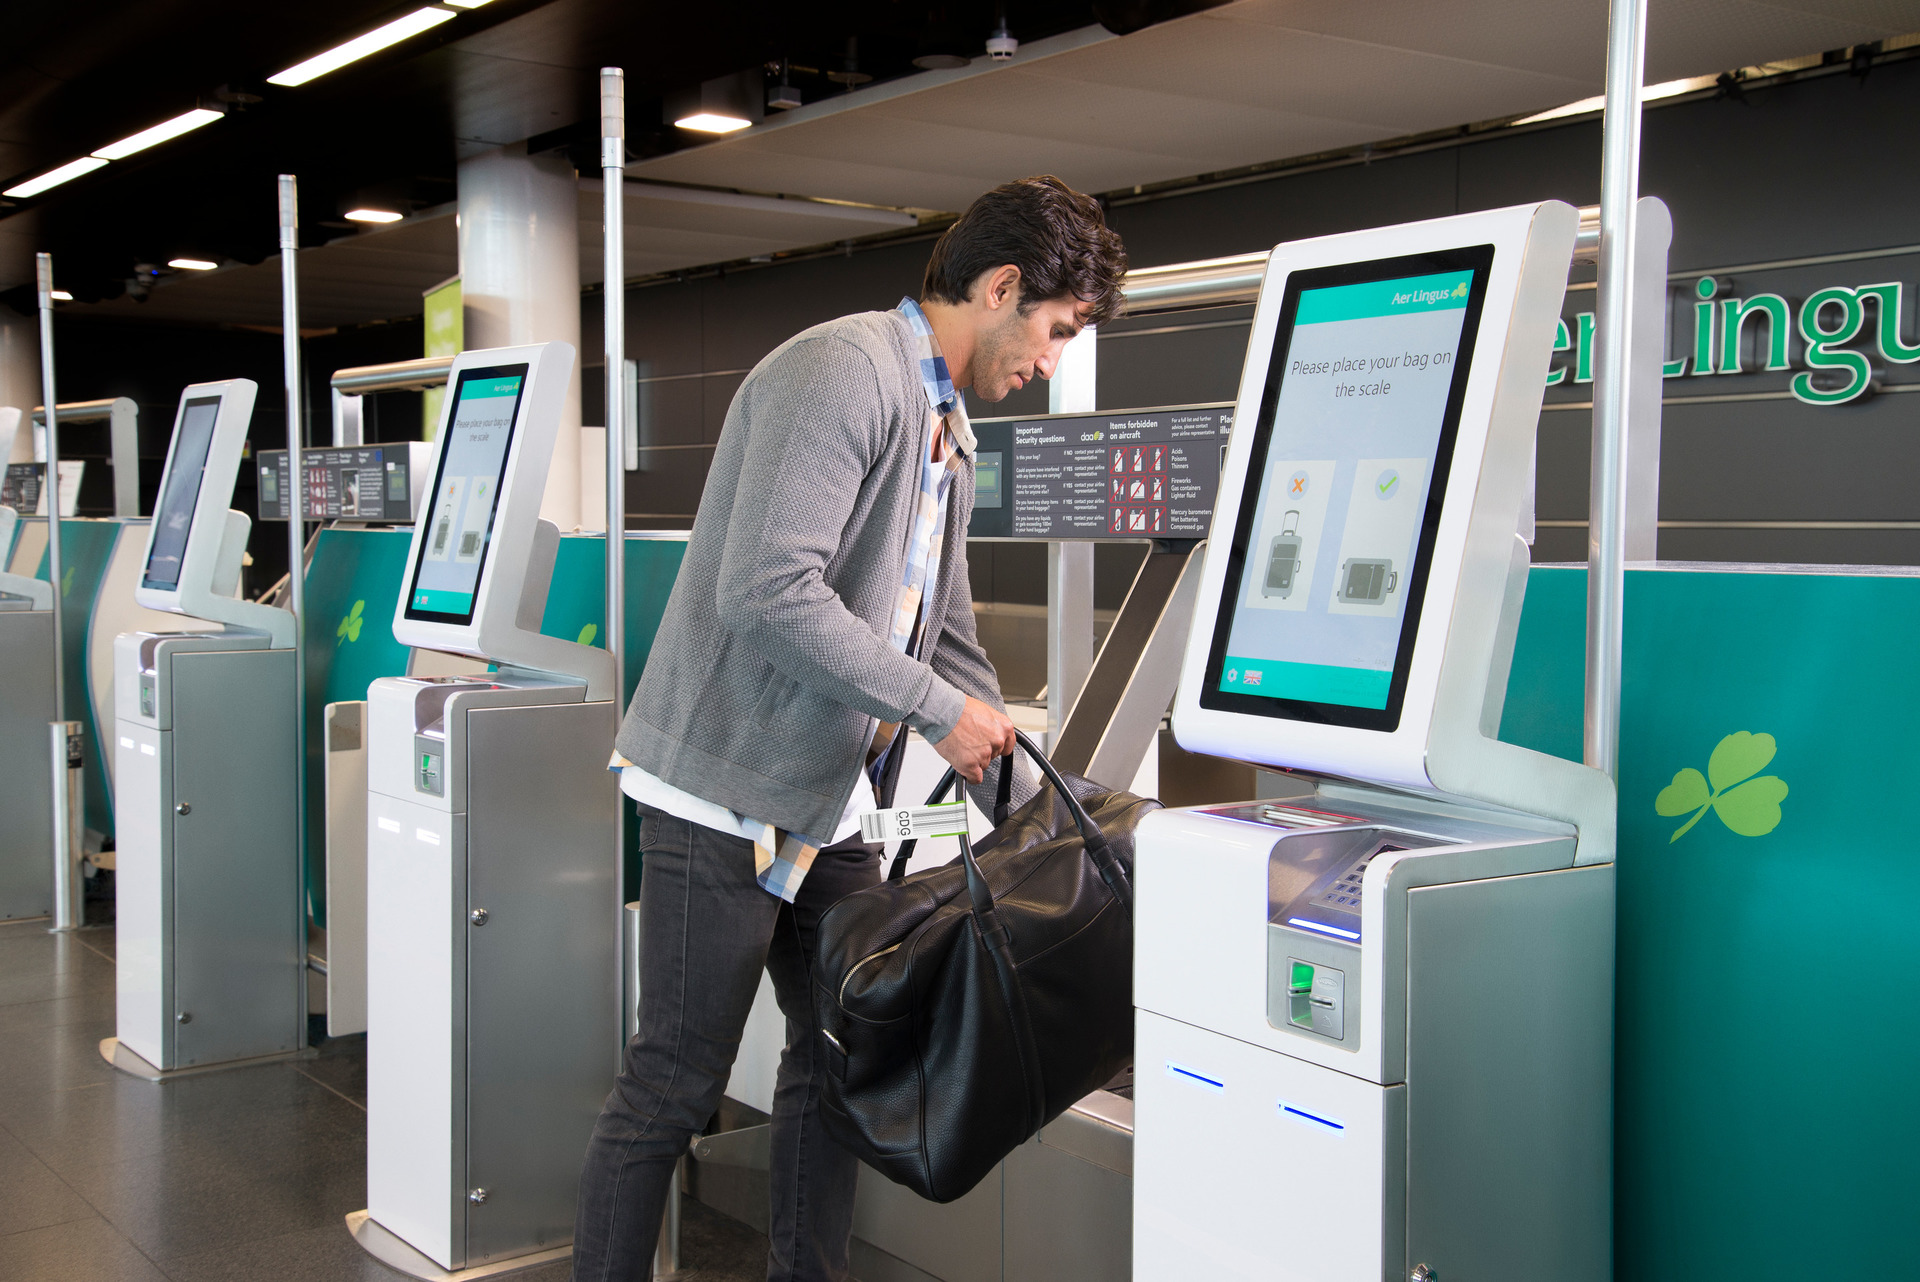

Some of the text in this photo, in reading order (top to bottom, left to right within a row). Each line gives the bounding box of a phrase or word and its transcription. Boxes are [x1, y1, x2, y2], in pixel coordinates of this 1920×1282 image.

[1392, 289, 1449, 305] Aer Lingus
[1546, 275, 1920, 406] er ingu
[1292, 352, 1451, 376] Please place your bag on
[1336, 380, 1390, 398] the scale
[1128, 420, 1158, 429] forbidden
[1220, 426, 1231, 434] illu
[1039, 436, 1065, 444] questions
[1081, 432, 1094, 441] daa
[1119, 431, 1140, 439] aircraft
[898, 810, 911, 836] CDG
